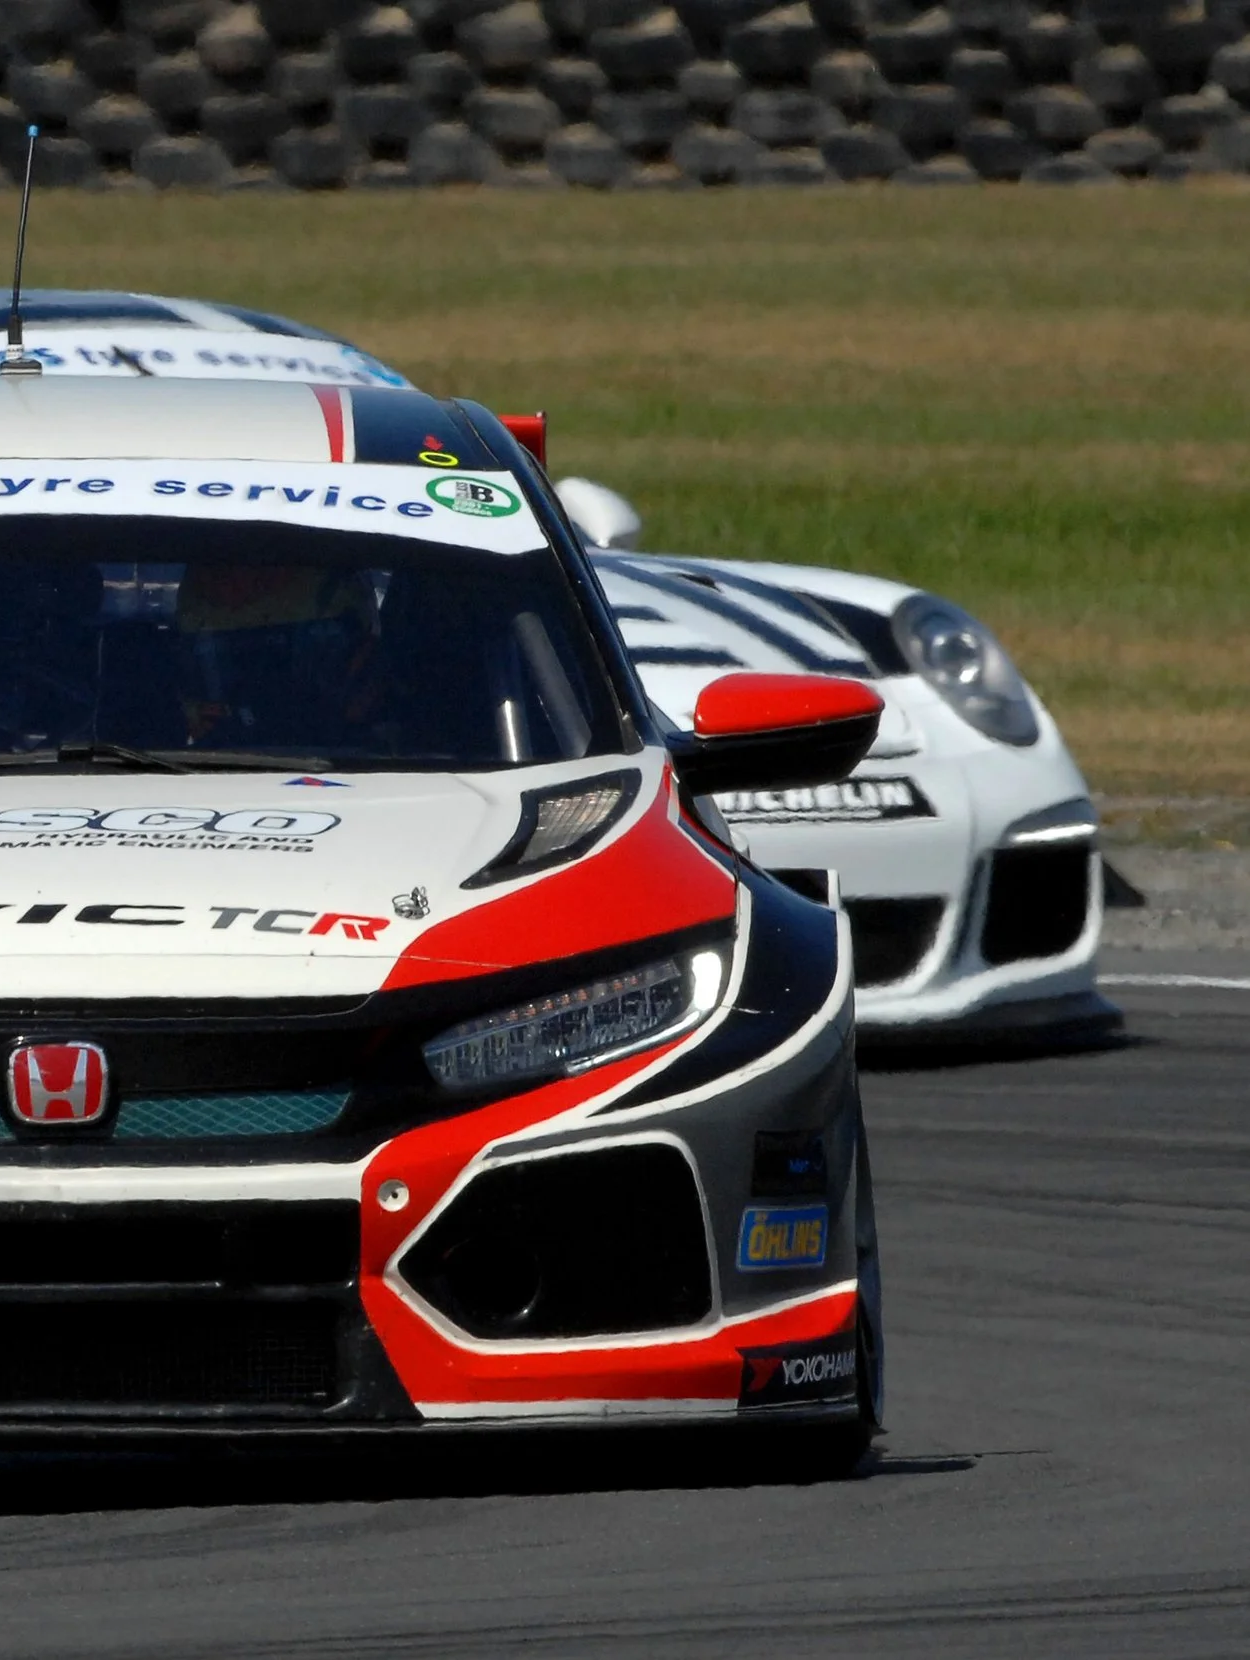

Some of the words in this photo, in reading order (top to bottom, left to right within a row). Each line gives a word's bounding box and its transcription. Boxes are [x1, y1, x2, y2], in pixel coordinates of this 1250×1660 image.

[153, 479, 435, 518] service
[35, 833, 230, 841] HYDRAULIC
[238, 835, 314, 843] AND
[117, 840, 315, 852] ENGINEERS
[208, 905, 391, 941] TCR
[748, 1211, 823, 1260] ÖHLINS
